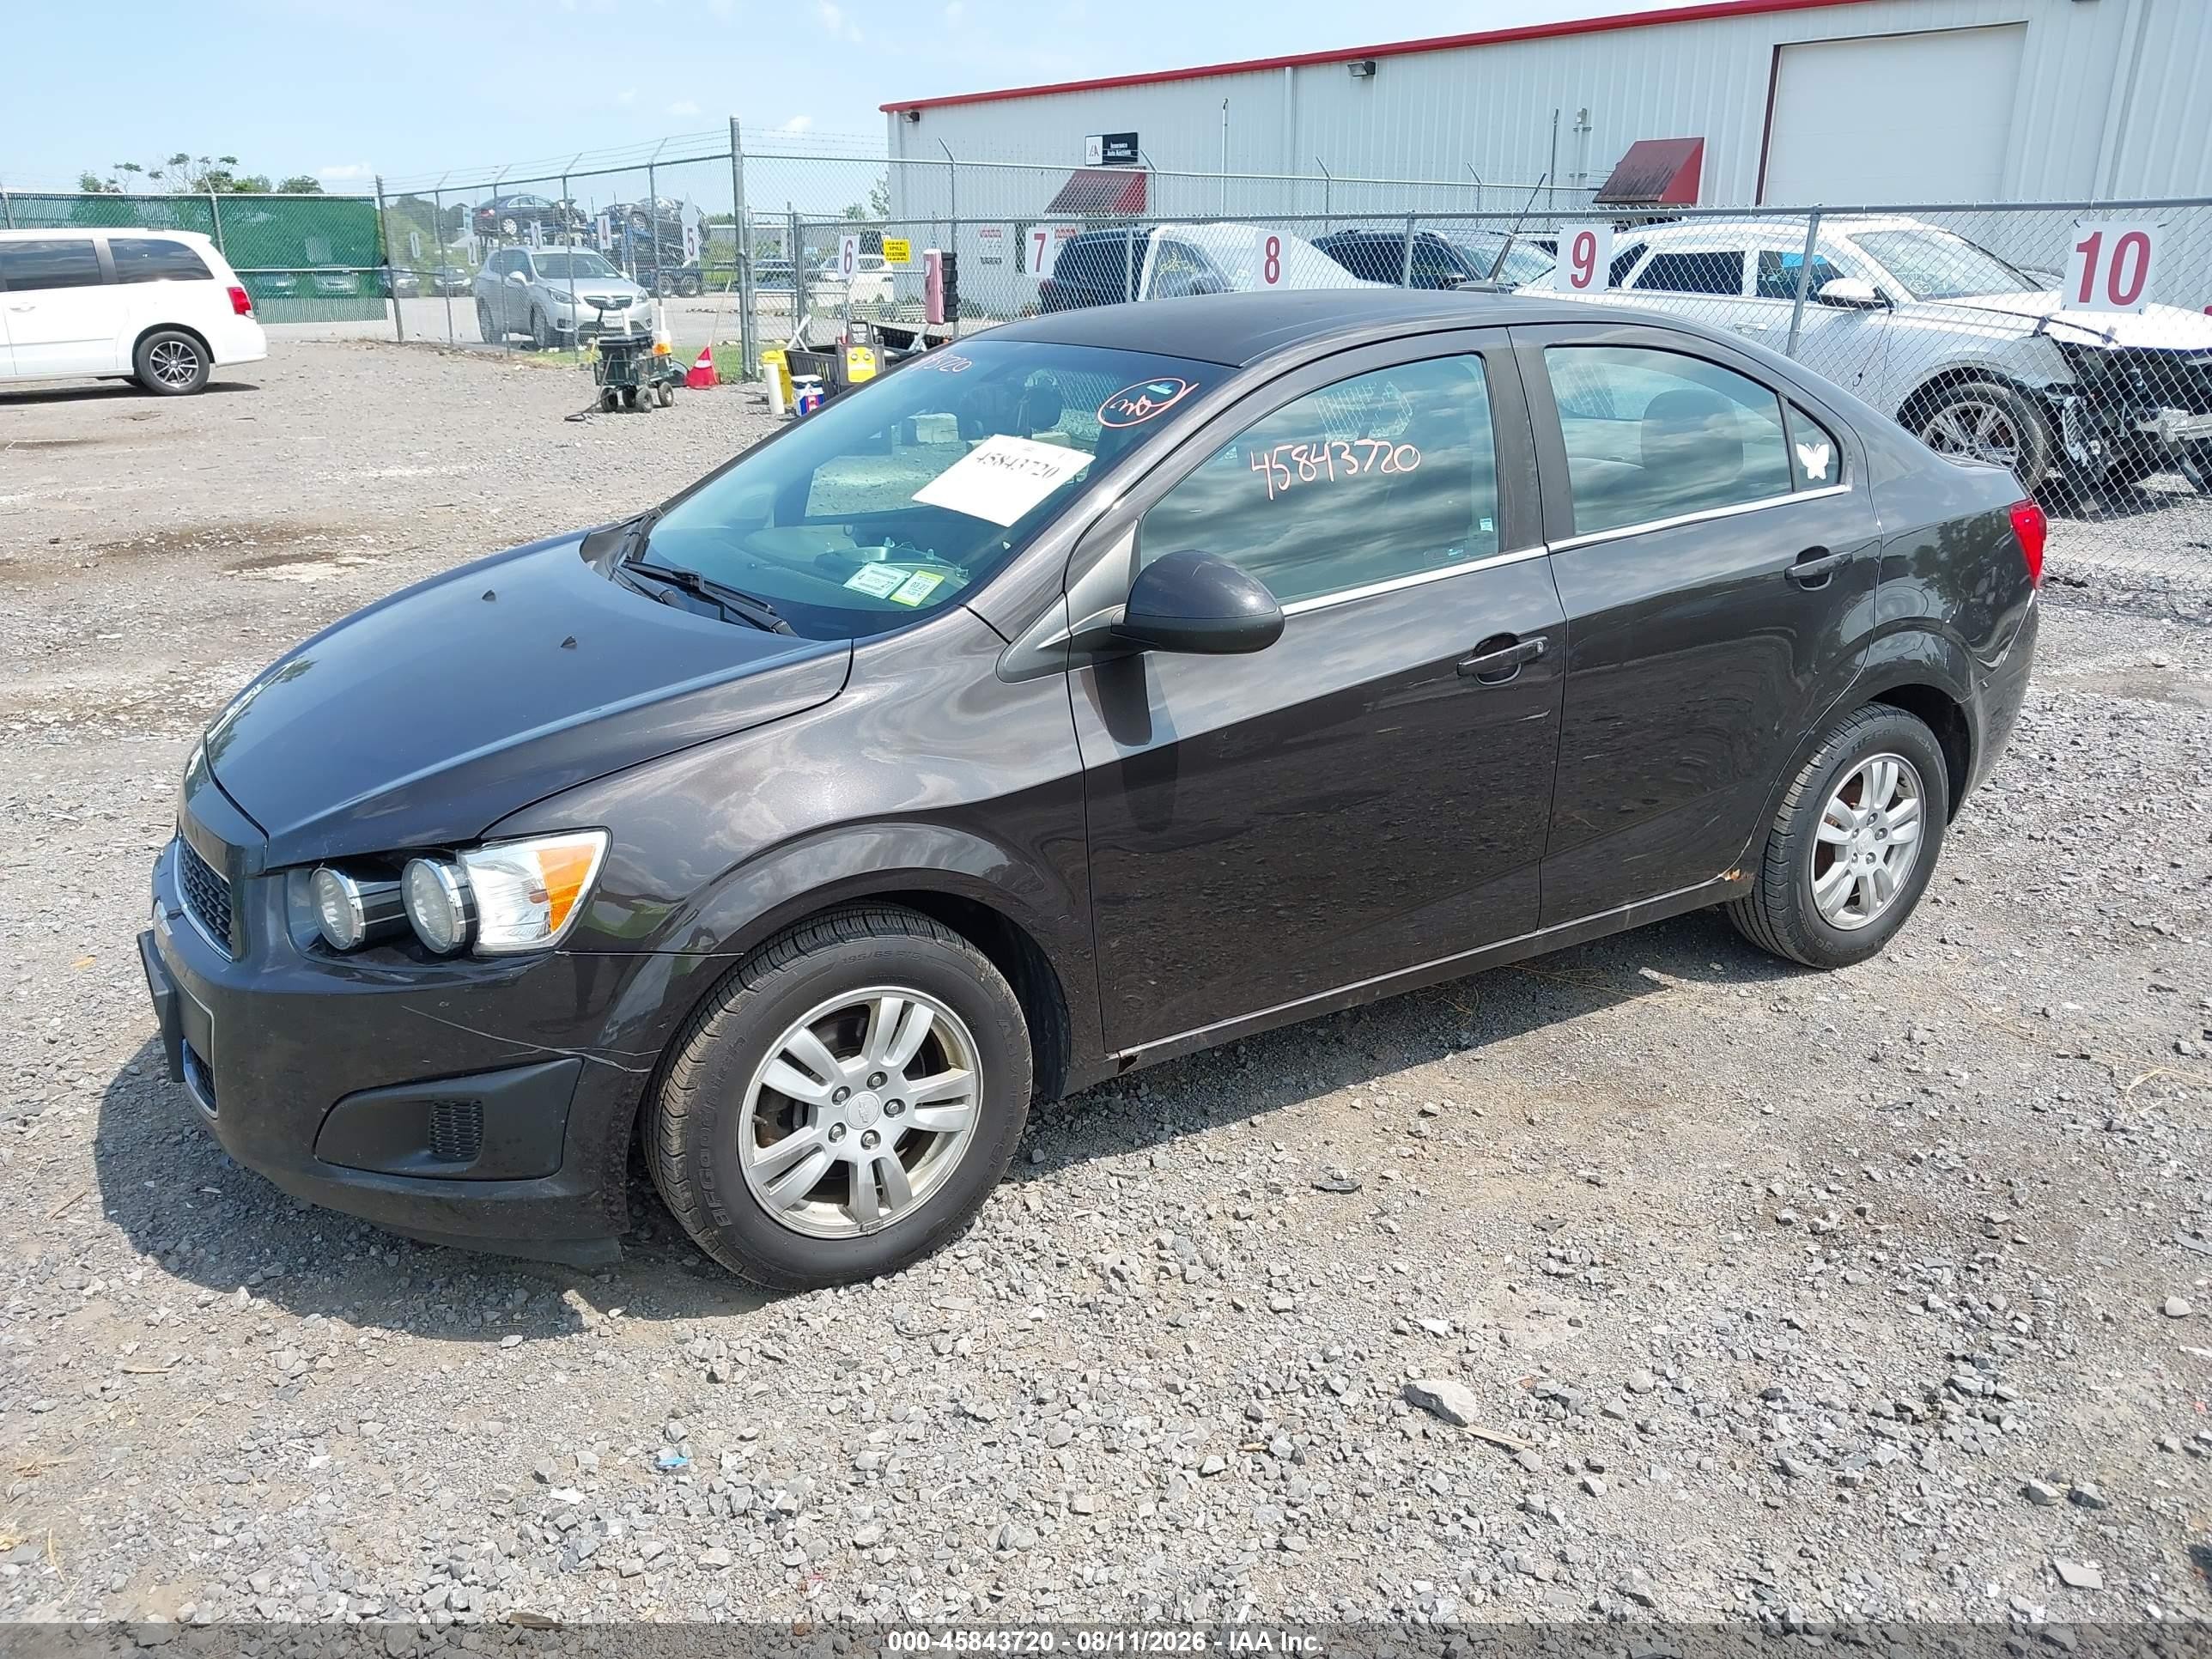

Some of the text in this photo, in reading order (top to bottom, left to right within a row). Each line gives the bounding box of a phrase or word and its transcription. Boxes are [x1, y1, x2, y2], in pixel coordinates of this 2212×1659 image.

[601, 218, 609, 246] 4
[687, 227, 695, 257] 5
[1033, 233, 1047, 273] 7
[843, 240, 854, 275] 6
[1264, 235, 1280, 285] 8
[1570, 231, 1597, 289] 9
[2075, 230, 2152, 307] 10
[1249, 438, 1422, 501] 45843720
